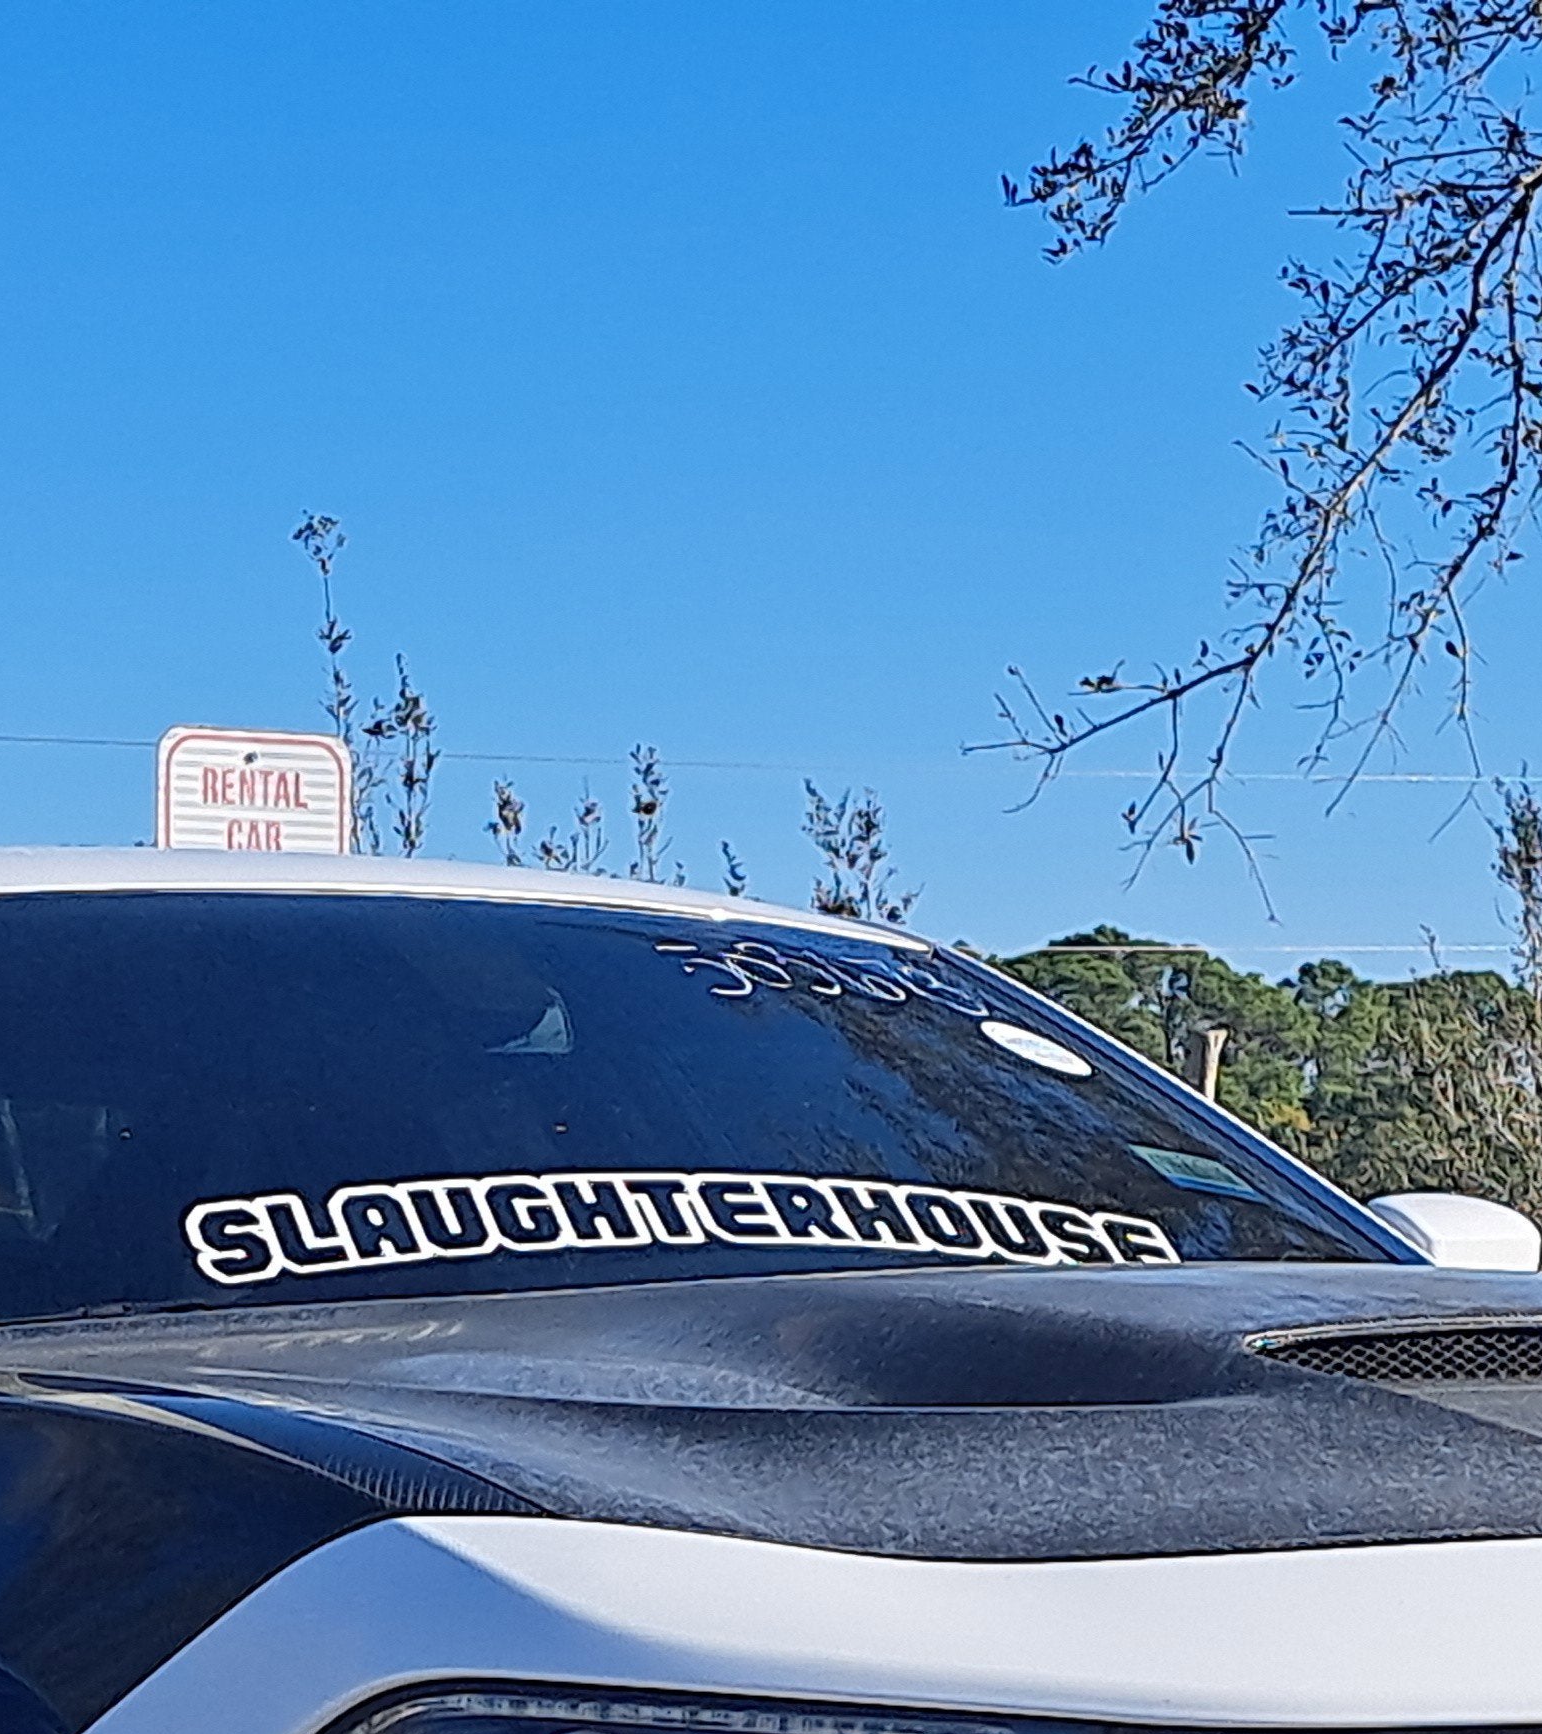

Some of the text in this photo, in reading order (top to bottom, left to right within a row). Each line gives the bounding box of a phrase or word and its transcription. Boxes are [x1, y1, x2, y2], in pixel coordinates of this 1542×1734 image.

[202, 766, 308, 809] RENTAL
[226, 818, 282, 850] CAR
[185, 1172, 1183, 1285] SLAUGHTERHOUSE
